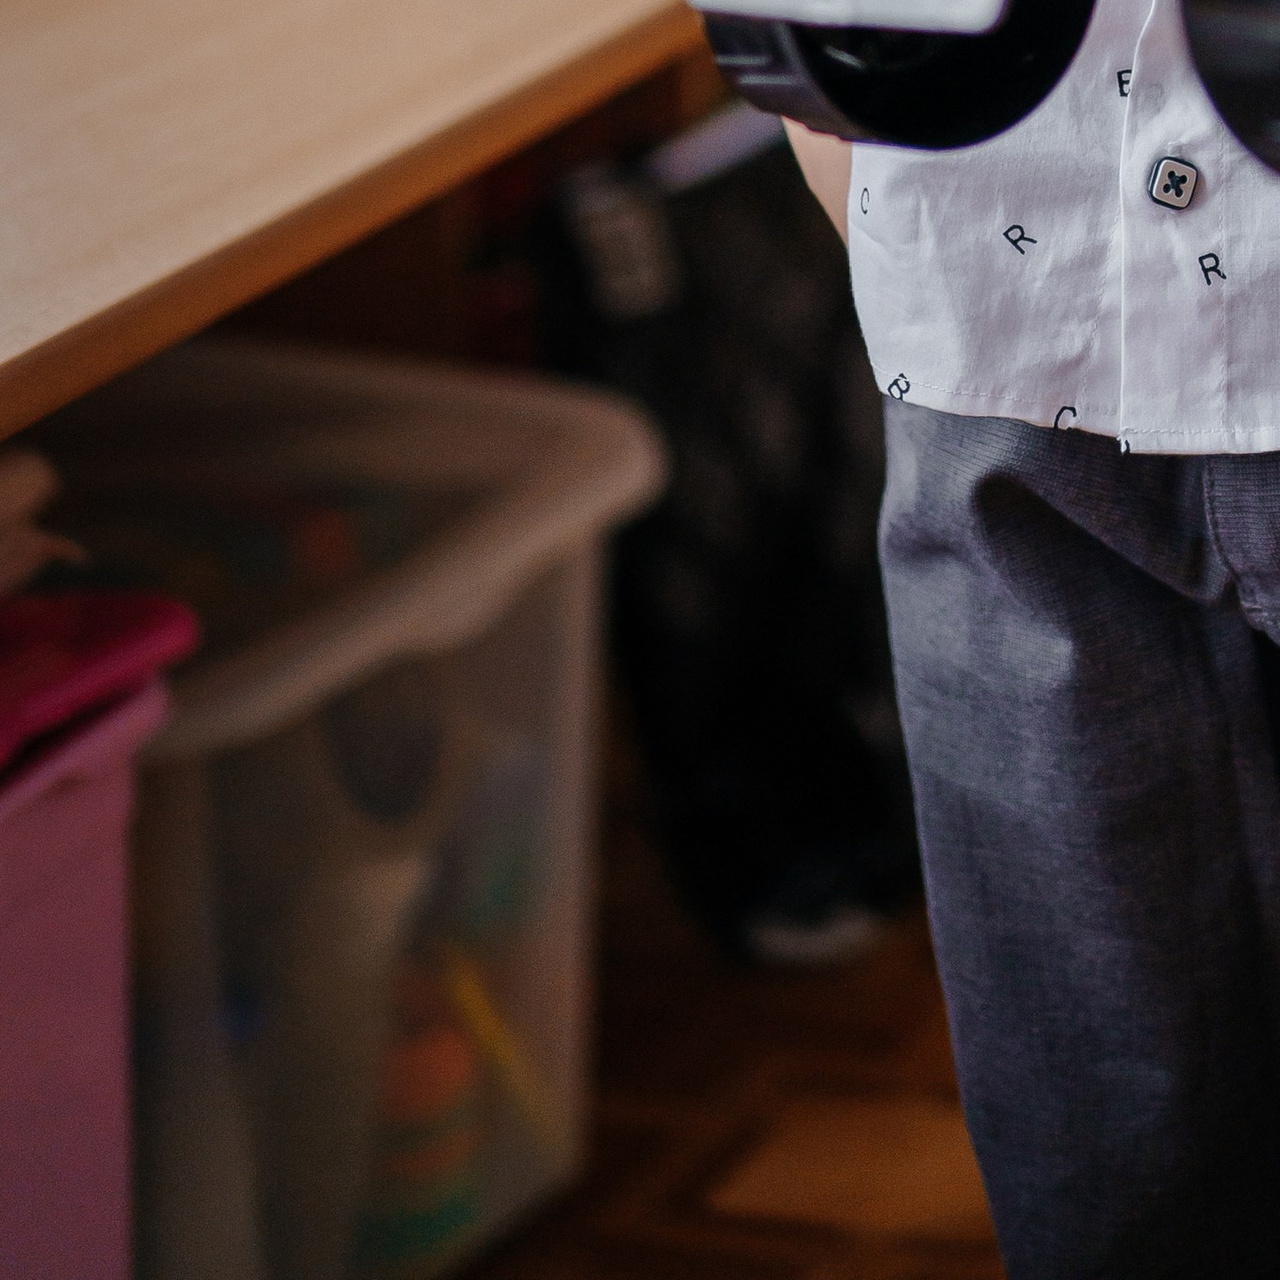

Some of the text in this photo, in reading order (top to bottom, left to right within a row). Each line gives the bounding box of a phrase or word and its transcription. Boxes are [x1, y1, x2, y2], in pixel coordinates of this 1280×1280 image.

[860, 186, 870, 215] C
[1002, 224, 1037, 255] R
[1198, 252, 1226, 285] R
